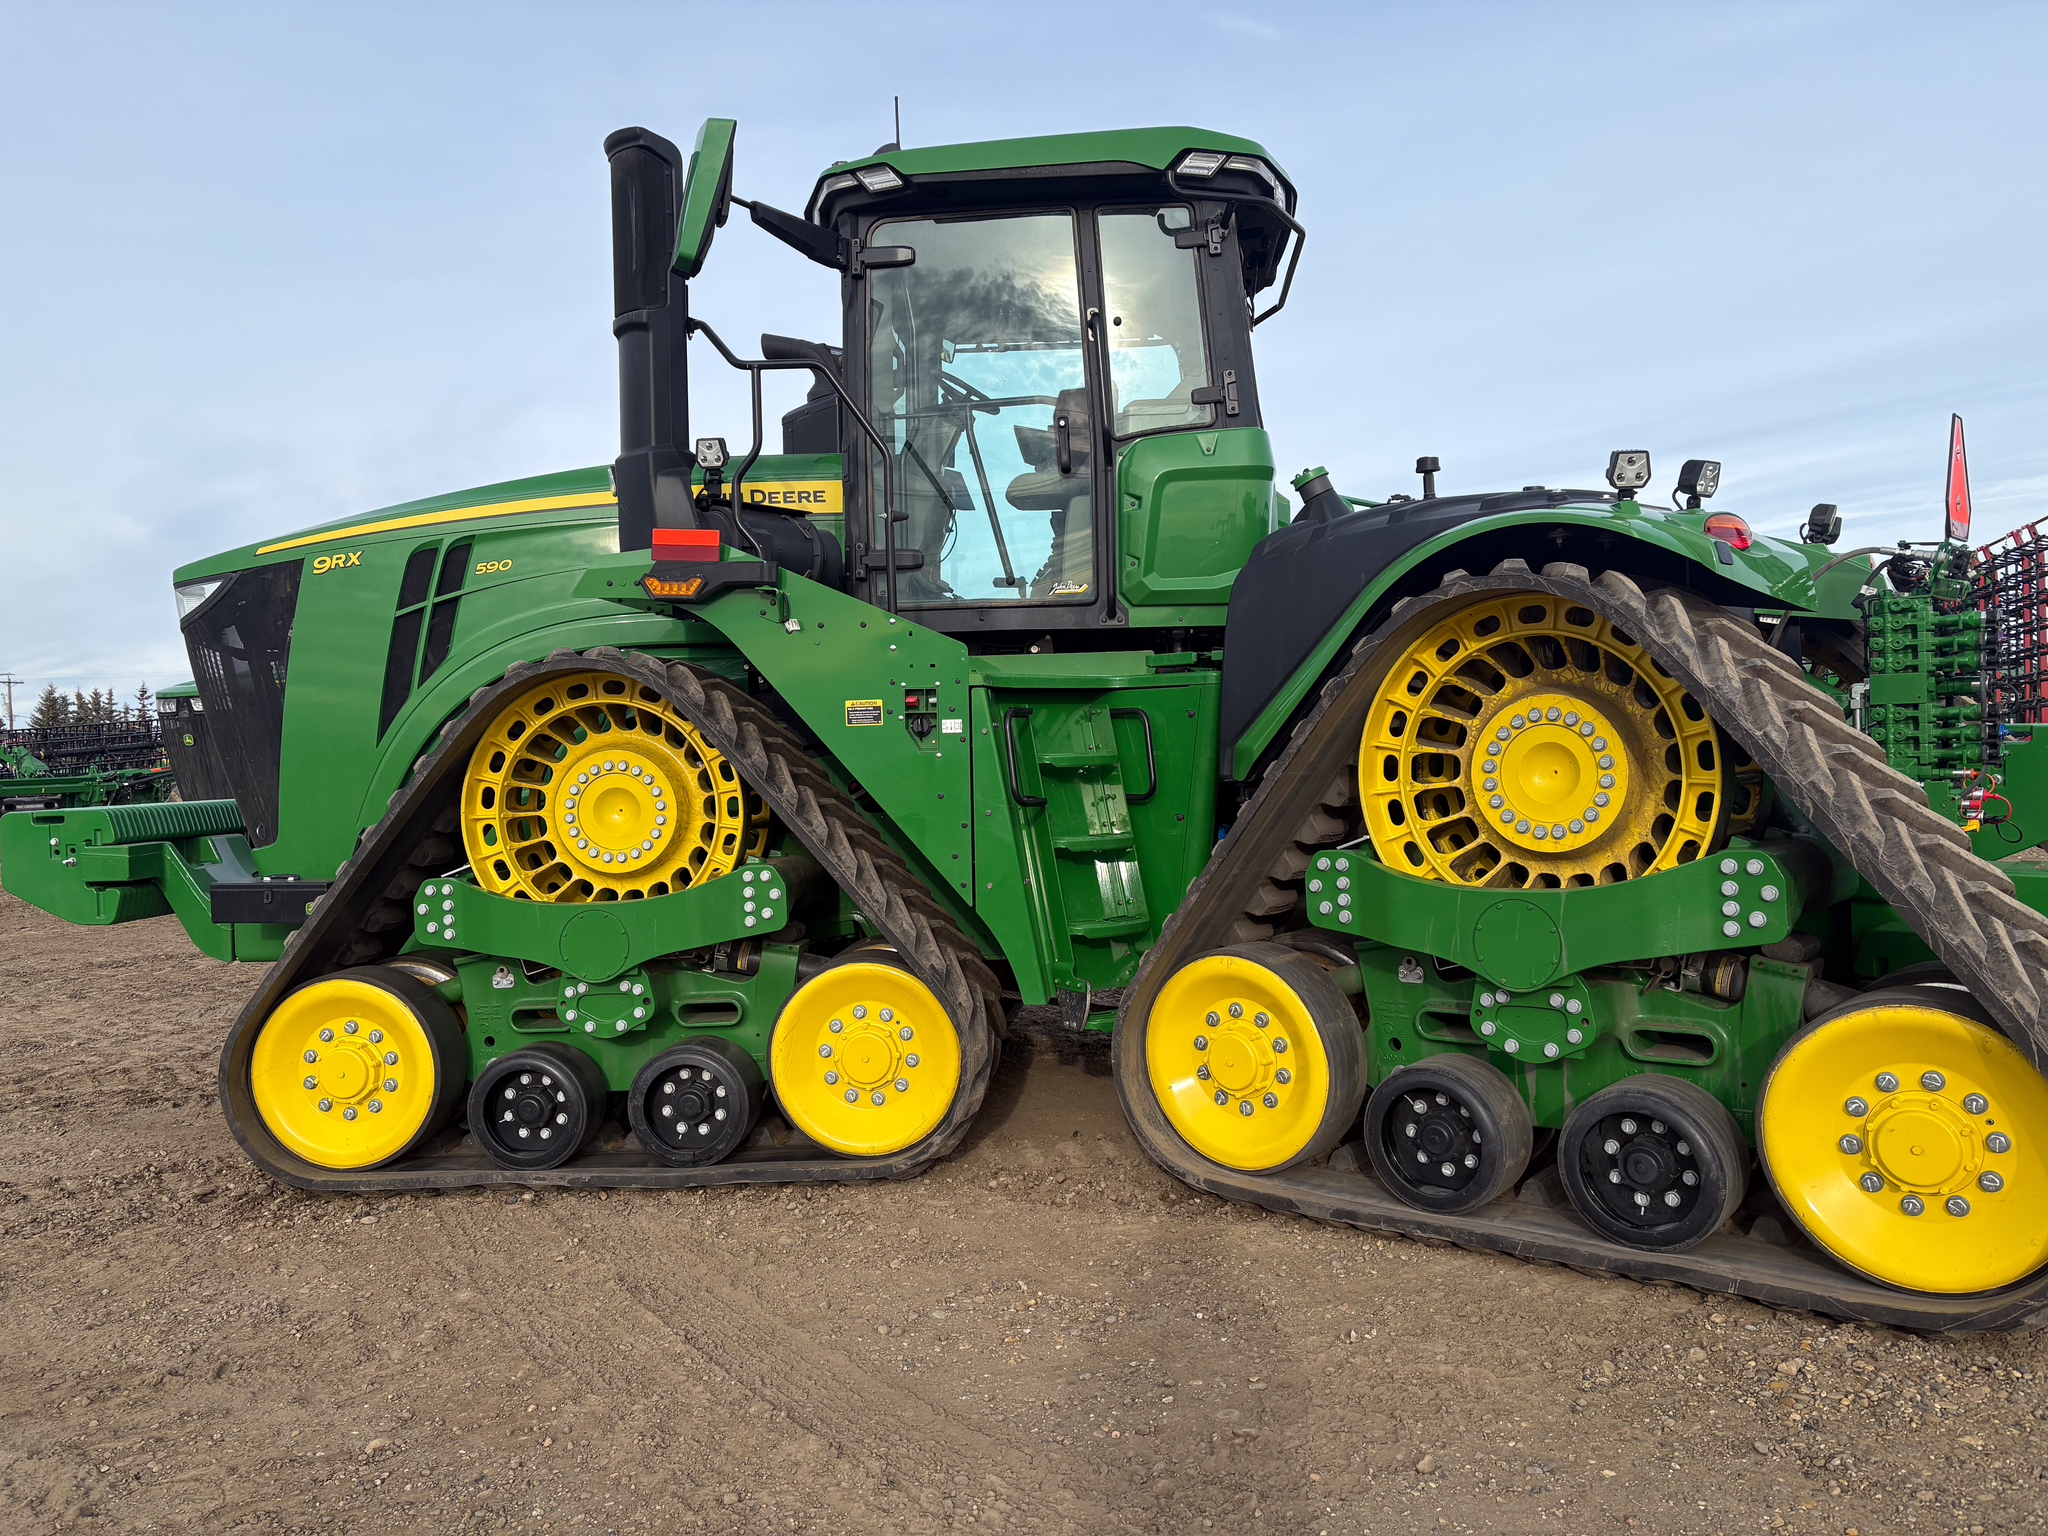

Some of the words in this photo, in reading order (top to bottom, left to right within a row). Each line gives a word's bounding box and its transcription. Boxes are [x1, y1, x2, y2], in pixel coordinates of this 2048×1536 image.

[750, 489, 827, 504] DEERE
[312, 550, 364, 575] 9RX
[475, 559, 513, 575] 590
